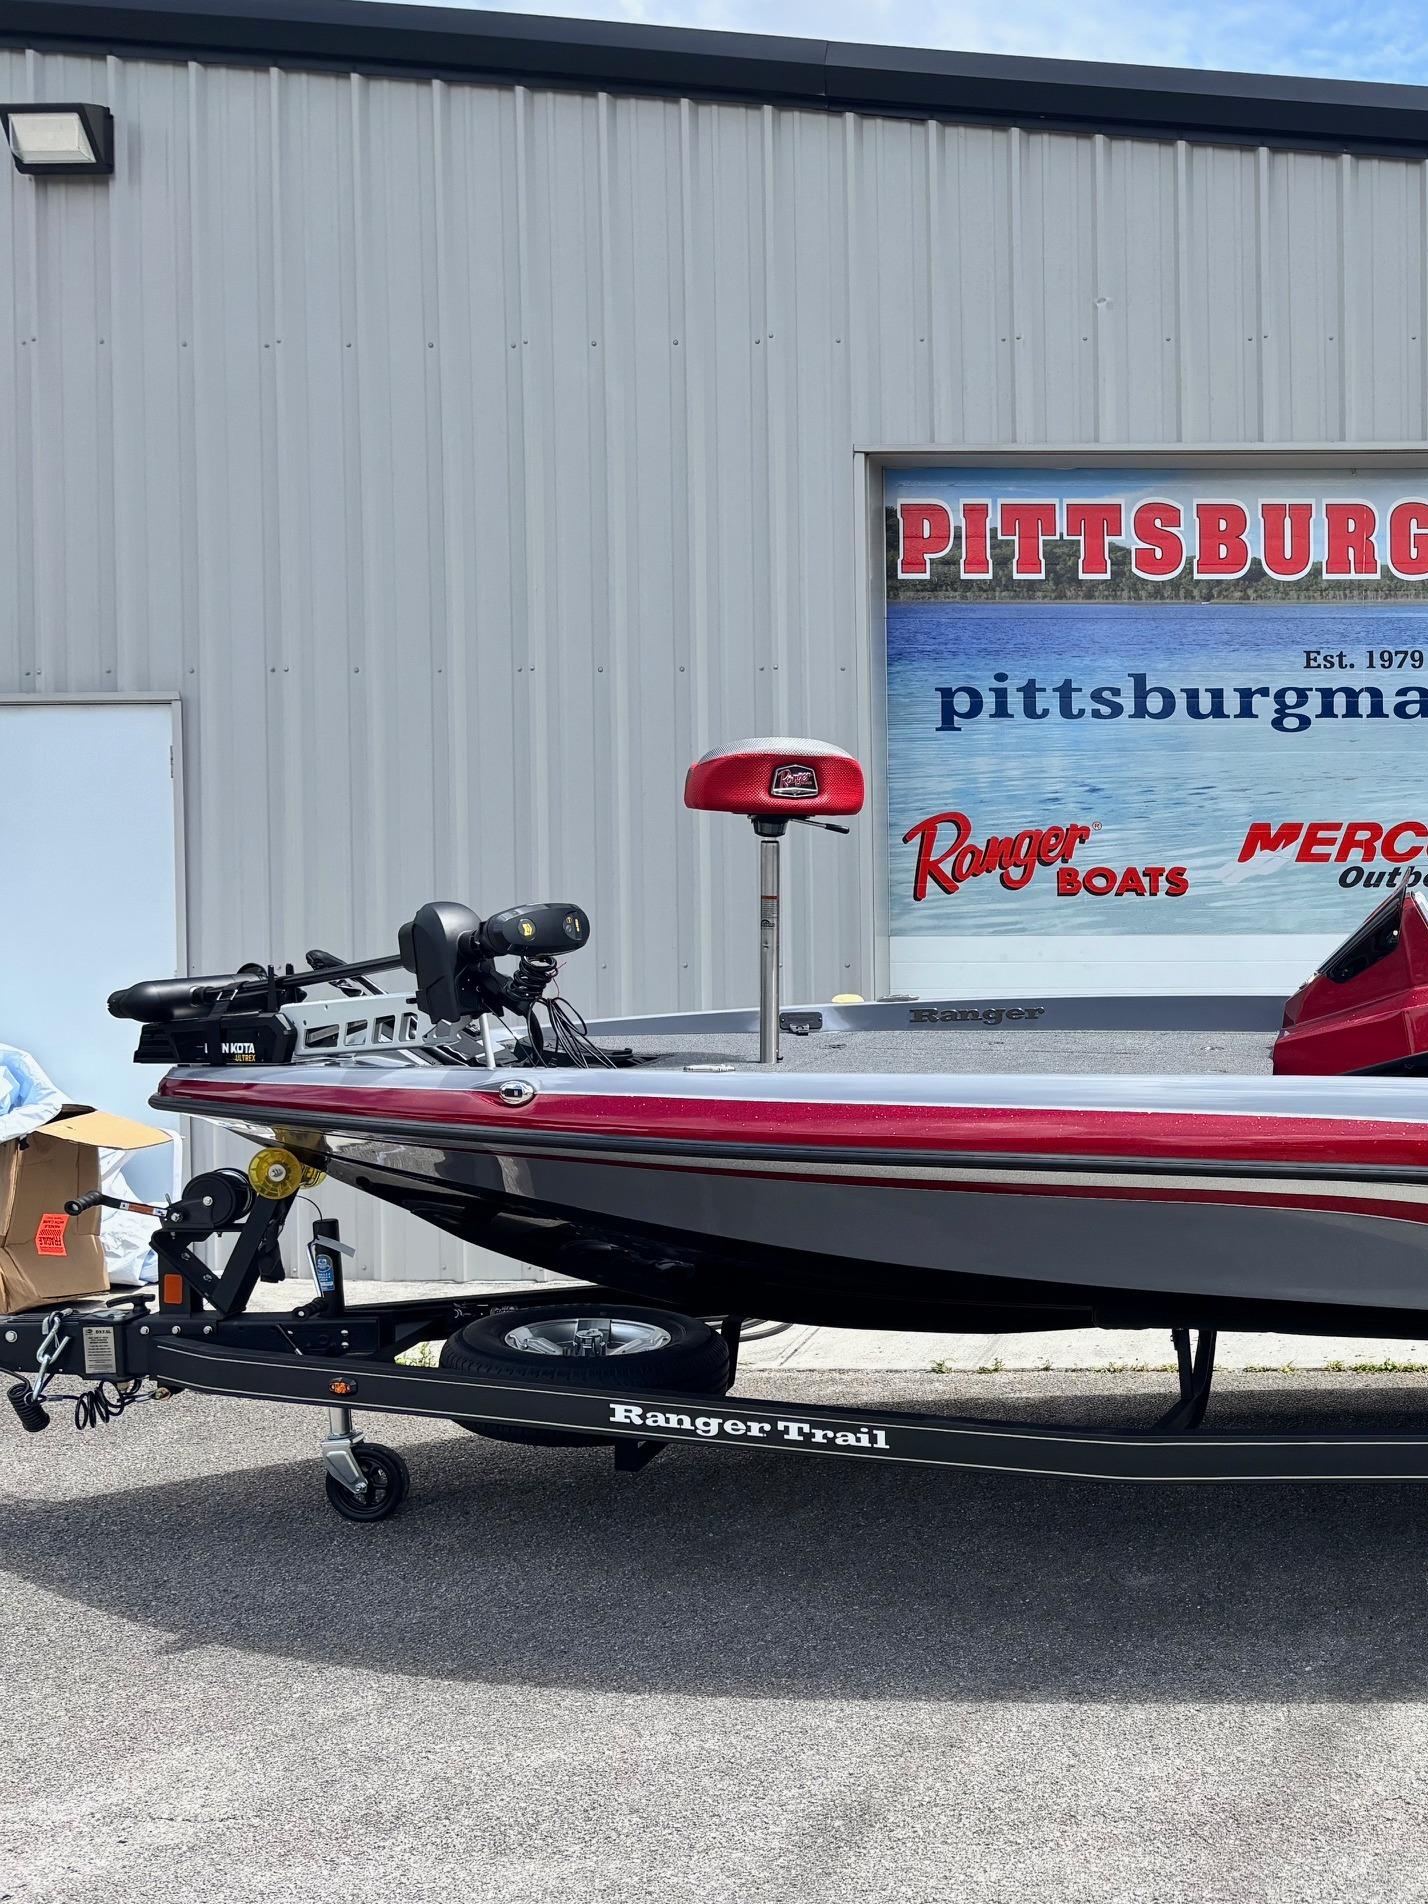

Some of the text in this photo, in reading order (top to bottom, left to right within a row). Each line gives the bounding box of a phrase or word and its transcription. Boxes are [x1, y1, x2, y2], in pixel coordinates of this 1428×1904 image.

[1303, 649, 1424, 669] Est. 1979
[902, 811, 1091, 901] Ranger
[1056, 866, 1189, 896] BOATS
[909, 1006, 1046, 1026] Ranger
[230, 1042, 256, 1054] KOTA
[609, 1403, 890, 1449] Ranger Trail
